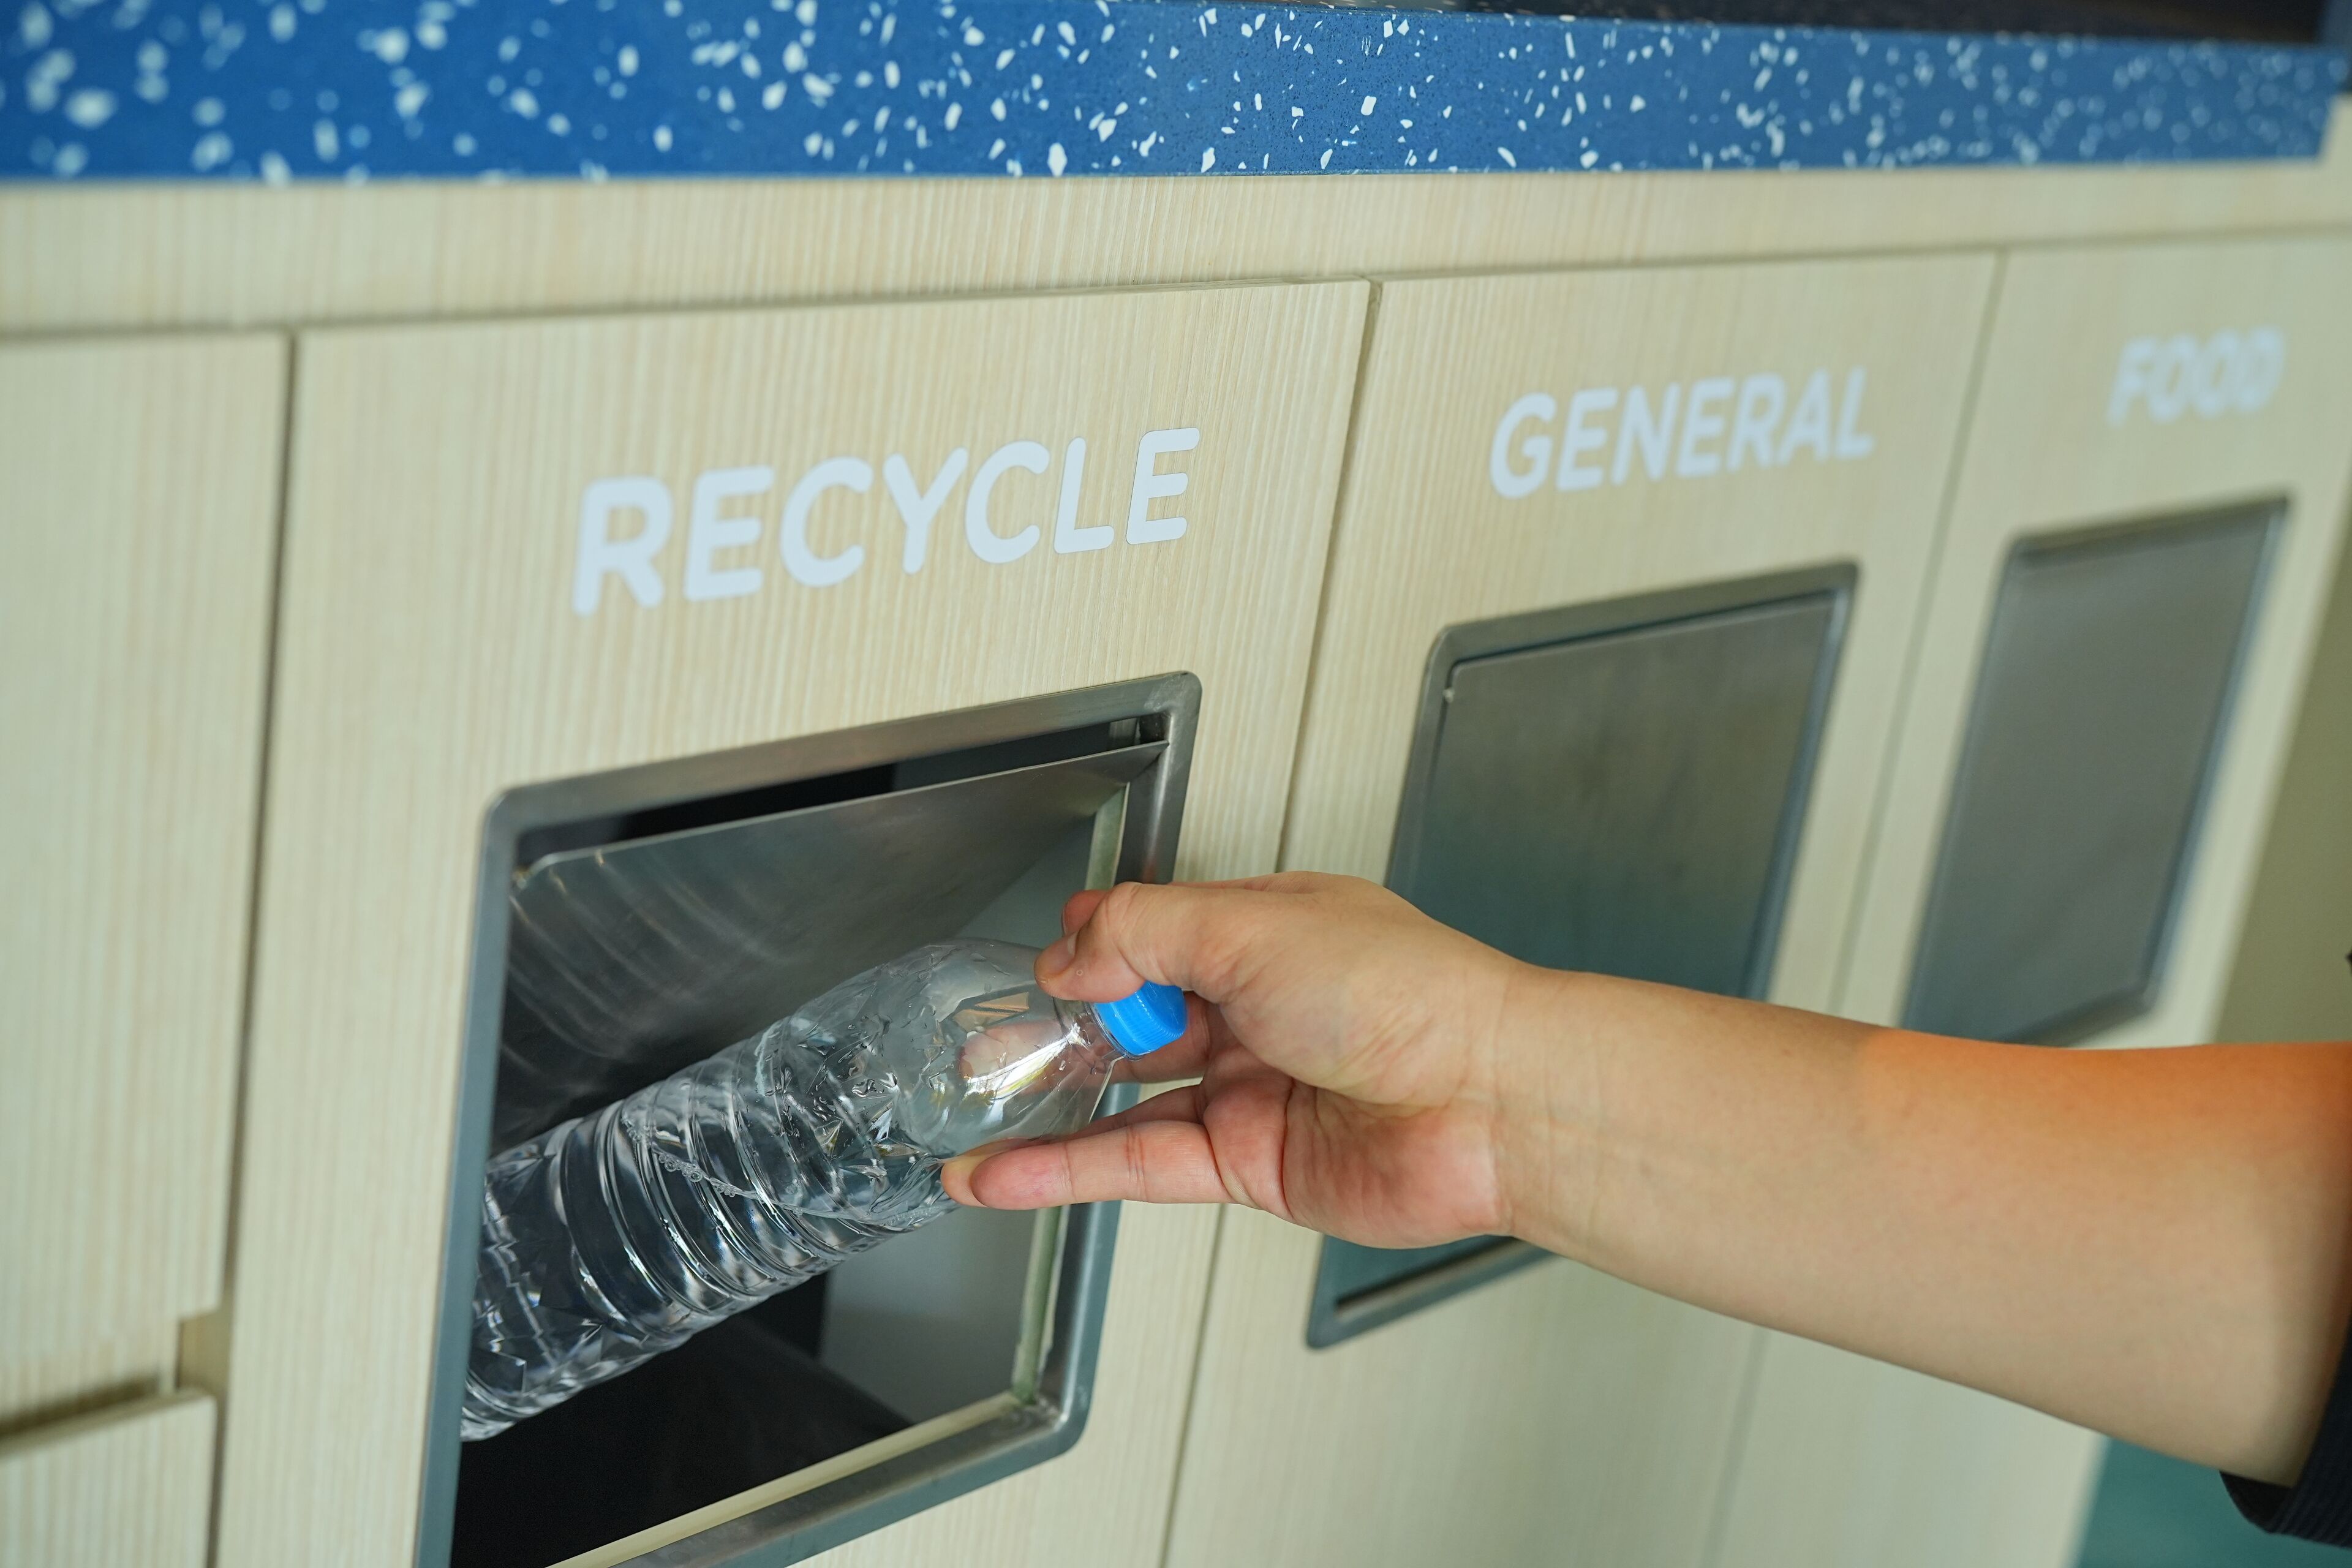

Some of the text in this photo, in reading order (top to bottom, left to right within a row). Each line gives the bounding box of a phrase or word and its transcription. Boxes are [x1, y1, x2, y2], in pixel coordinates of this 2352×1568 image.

[1489, 366, 1875, 499] GENERAL
[2107, 326, 2285, 426] FOOD
[571, 426, 1200, 616] RECYCLE
